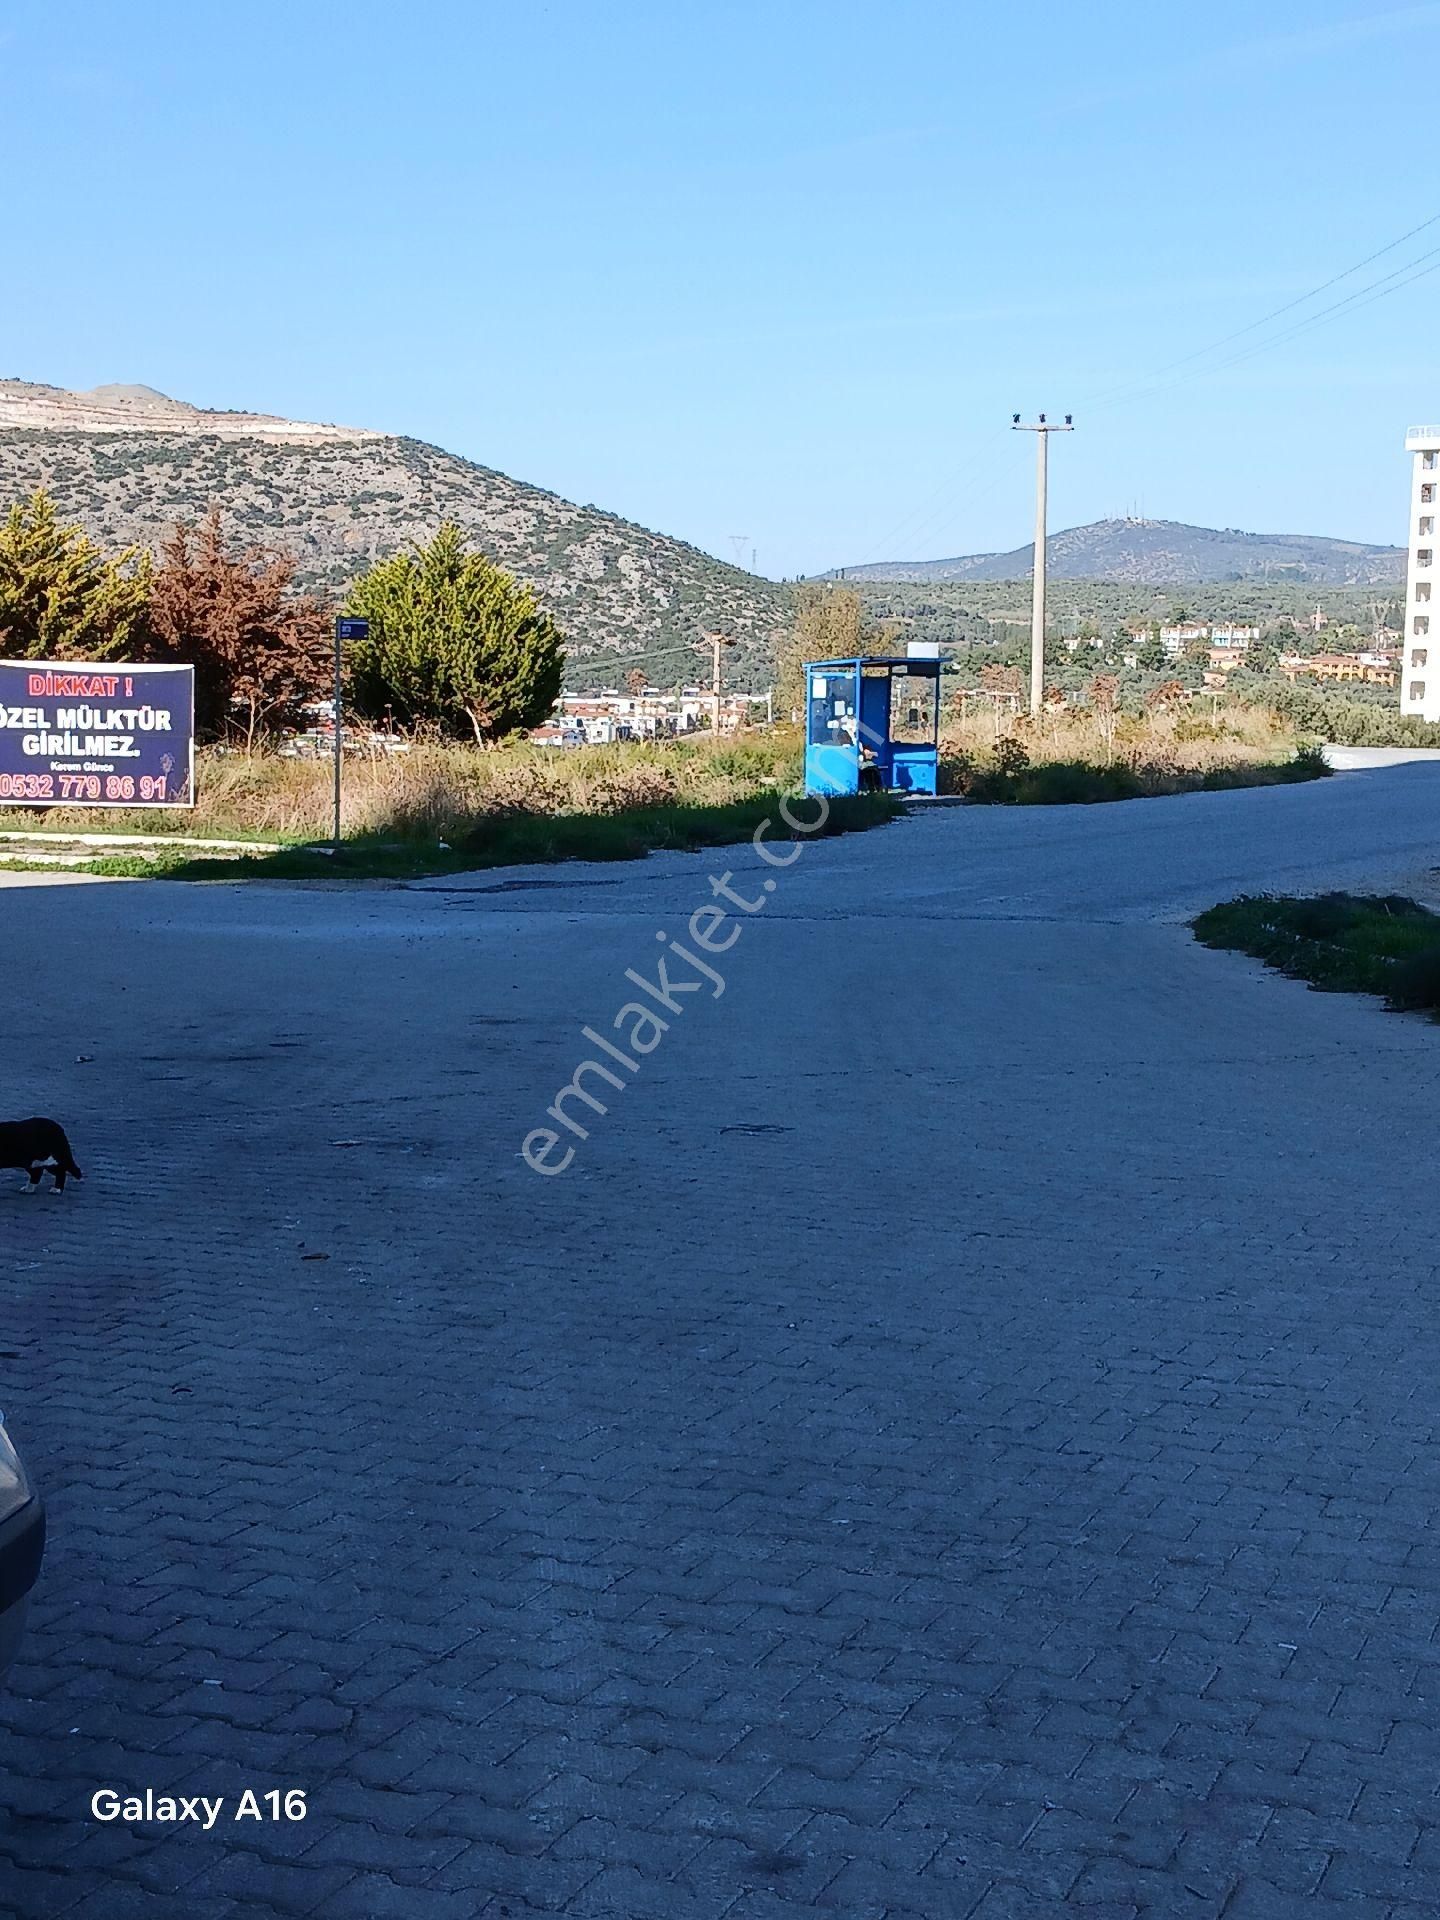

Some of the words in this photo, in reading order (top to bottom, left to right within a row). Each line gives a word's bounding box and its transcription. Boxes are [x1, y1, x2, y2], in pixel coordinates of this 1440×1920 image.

[28, 671, 119, 697] DİKKAT
[56, 704, 172, 731] MÜLKTÜR
[22, 730, 141, 758] GİRİLMEZ.
[0, 774, 54, 798] 0532
[59, 775, 101, 799] 779
[106, 775, 135, 799] 86
[139, 776, 167, 800] 91
